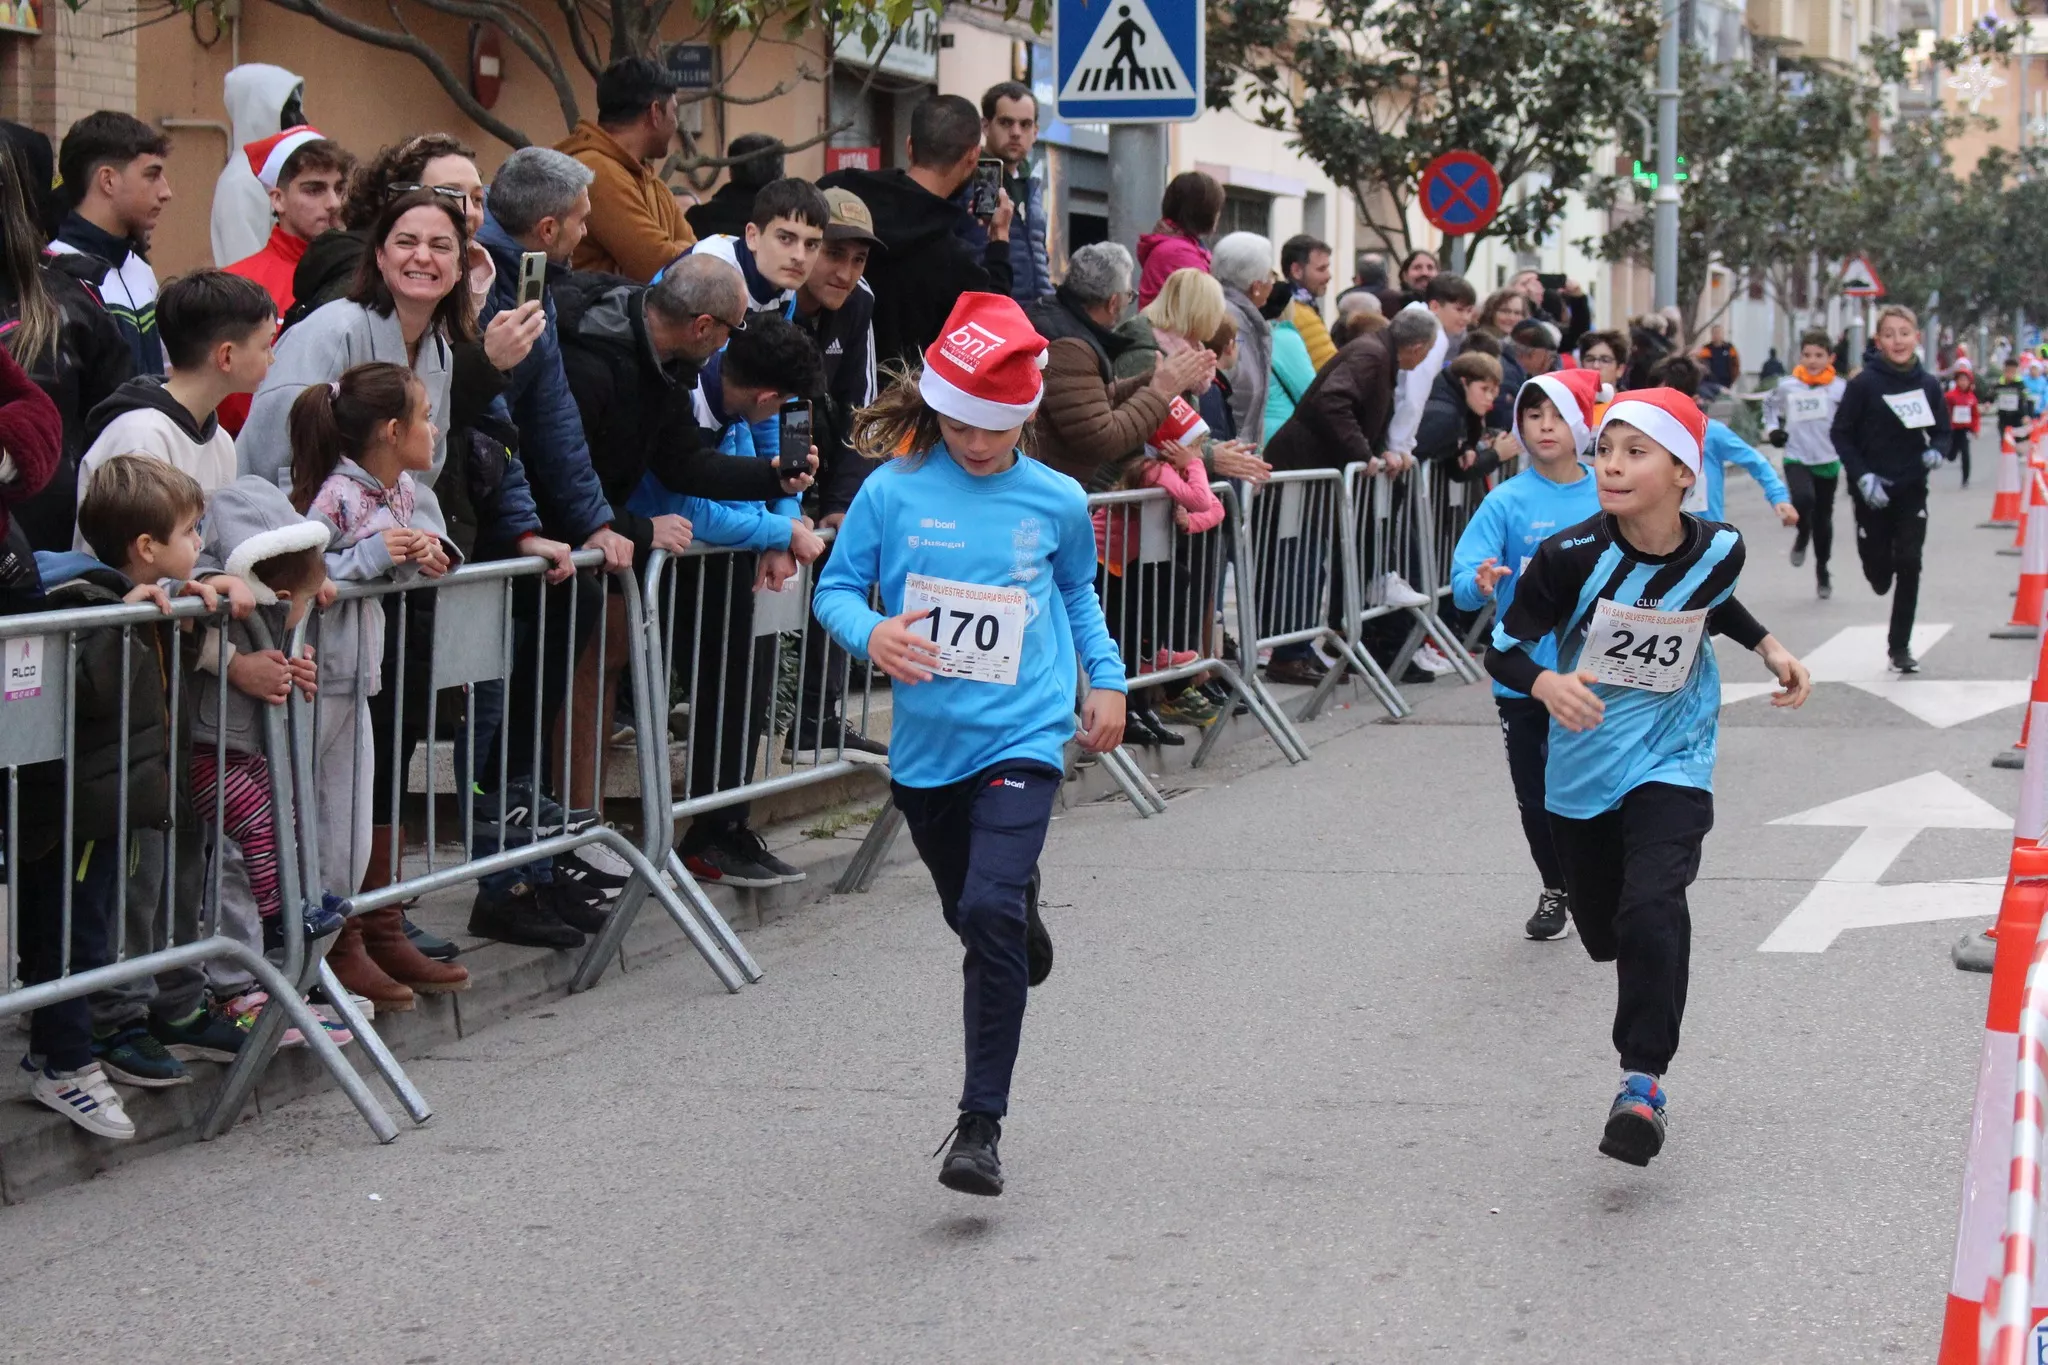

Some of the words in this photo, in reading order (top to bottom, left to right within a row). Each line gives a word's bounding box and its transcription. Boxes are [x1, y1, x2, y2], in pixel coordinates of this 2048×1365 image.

[946, 325, 1001, 359] bnf
[1894, 402, 1923, 419] 330
[921, 539, 965, 548] Jusegal
[920, 582, 933, 592] SAN
[933, 585, 965, 598] SILVESTRE
[965, 590, 997, 601] SOLIDARIA
[1636, 598, 1665, 607] CLUB
[1612, 608, 1624, 619] SAN
[1624, 612, 1657, 624] SILVESTRE
[1657, 616, 1685, 625] SOLIDARIA
[925, 606, 1000, 651] 170
[1604, 630, 1683, 667] 243
[12, 665, 36, 678] ALCO
